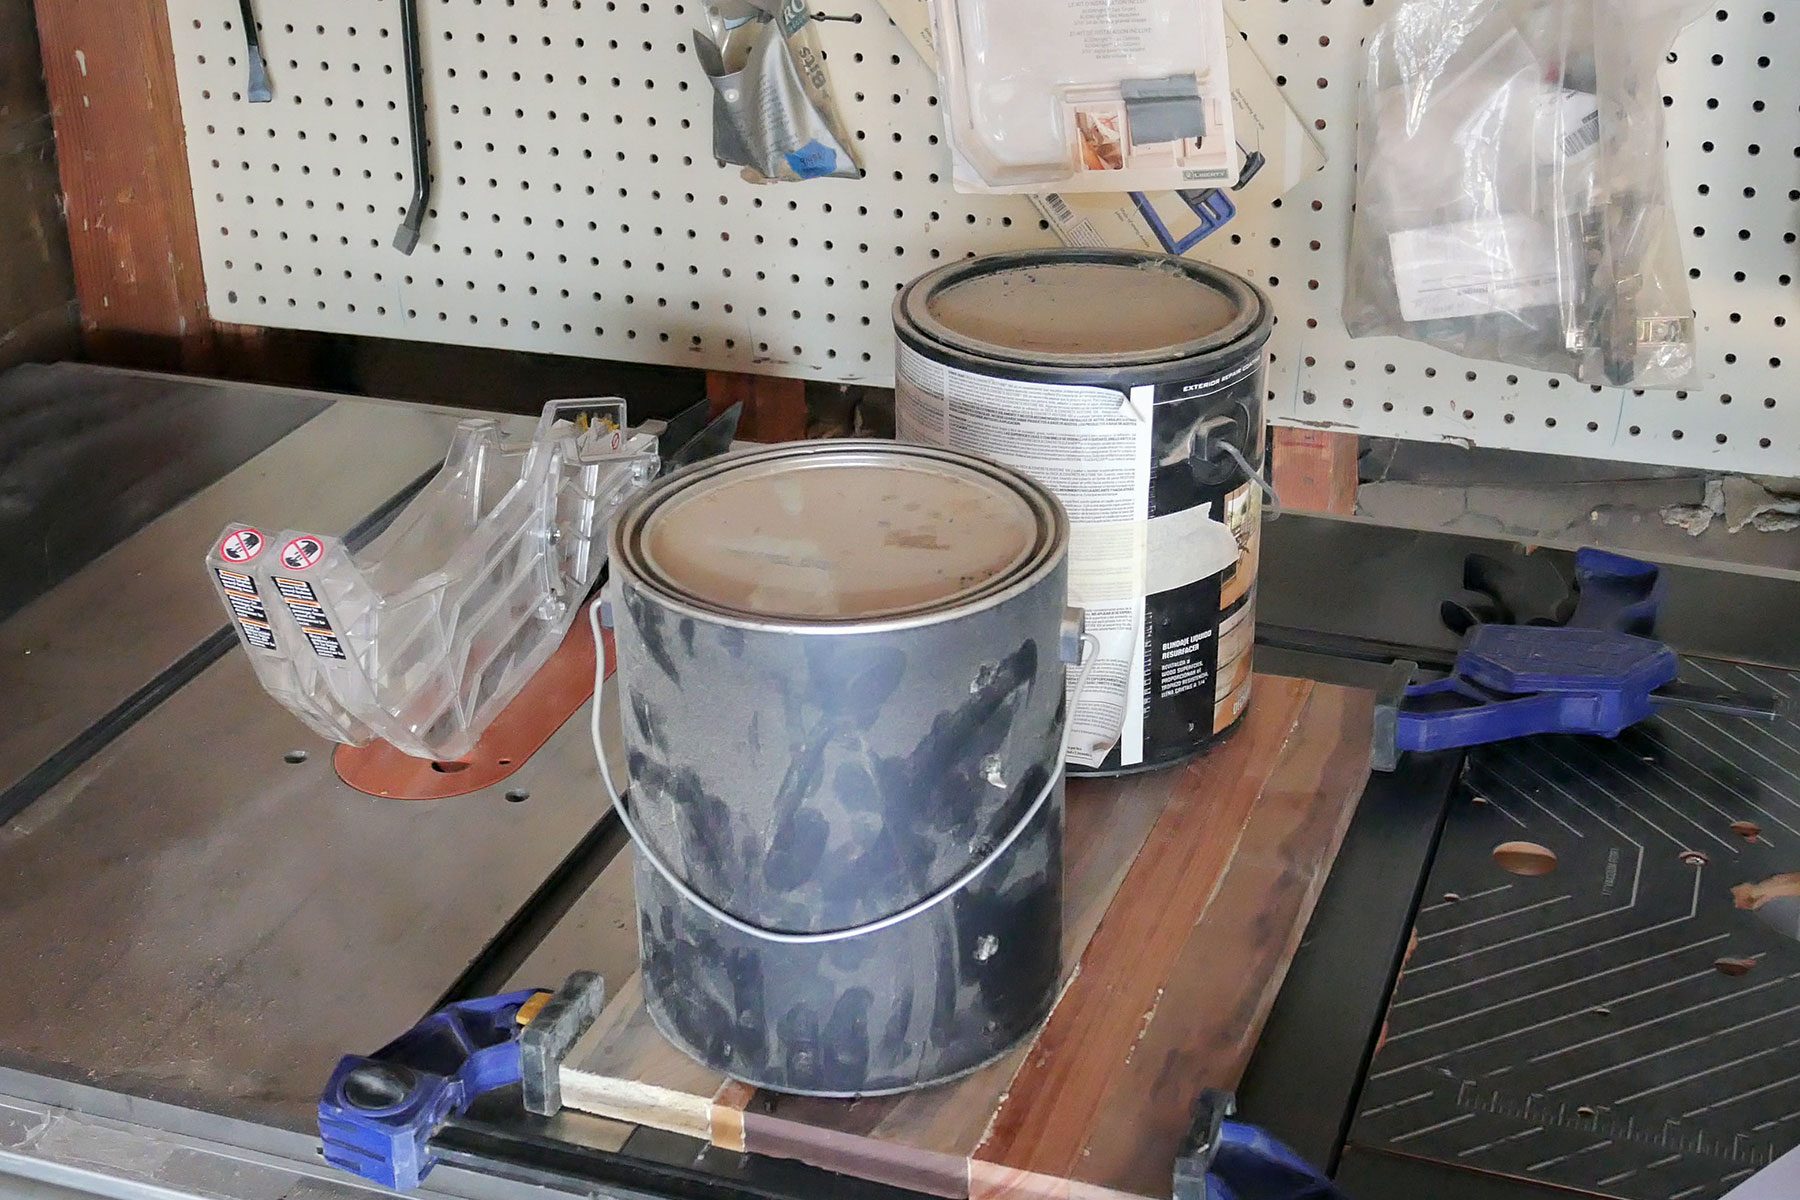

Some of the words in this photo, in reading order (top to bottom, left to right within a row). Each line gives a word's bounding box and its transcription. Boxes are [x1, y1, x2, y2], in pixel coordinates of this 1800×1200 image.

[799, 46, 826, 89] Bits
[1182, 377, 1220, 392] EXTERIOR
[1221, 367, 1242, 382] REPAIR
[1162, 636, 1190, 651] BLINDAJE
[1162, 643, 1199, 659] RESURFACER
